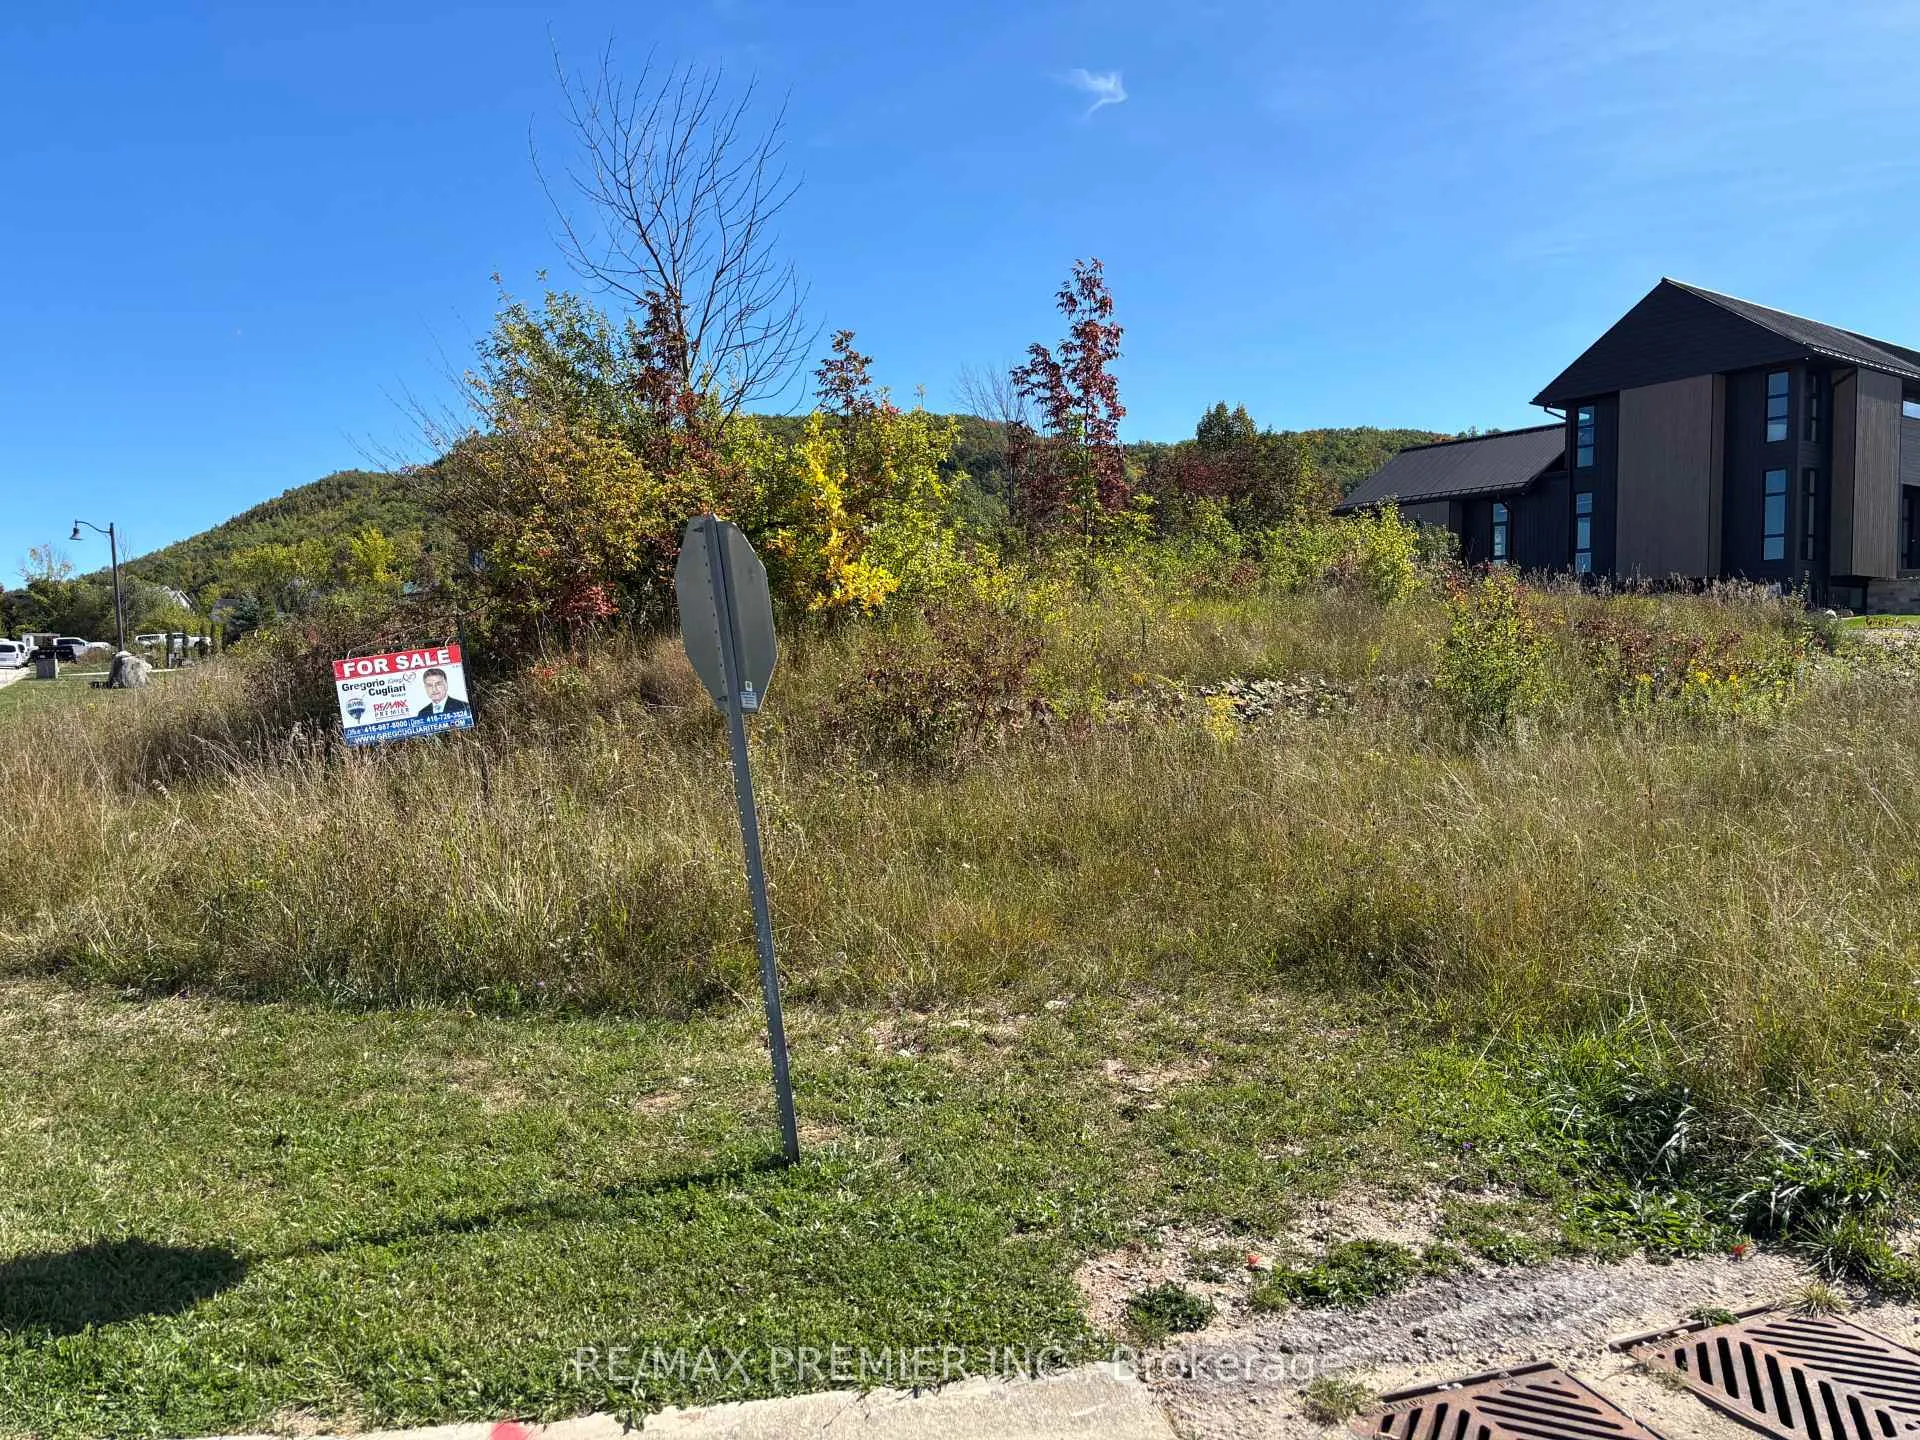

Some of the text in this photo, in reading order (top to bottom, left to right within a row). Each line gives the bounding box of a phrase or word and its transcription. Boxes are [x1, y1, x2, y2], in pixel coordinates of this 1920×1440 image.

[343, 649, 451, 678] FOR SALE
[341, 679, 385, 691] Gregorio
[368, 684, 406, 696] Cugliari
[373, 699, 408, 712] RE/MAX
